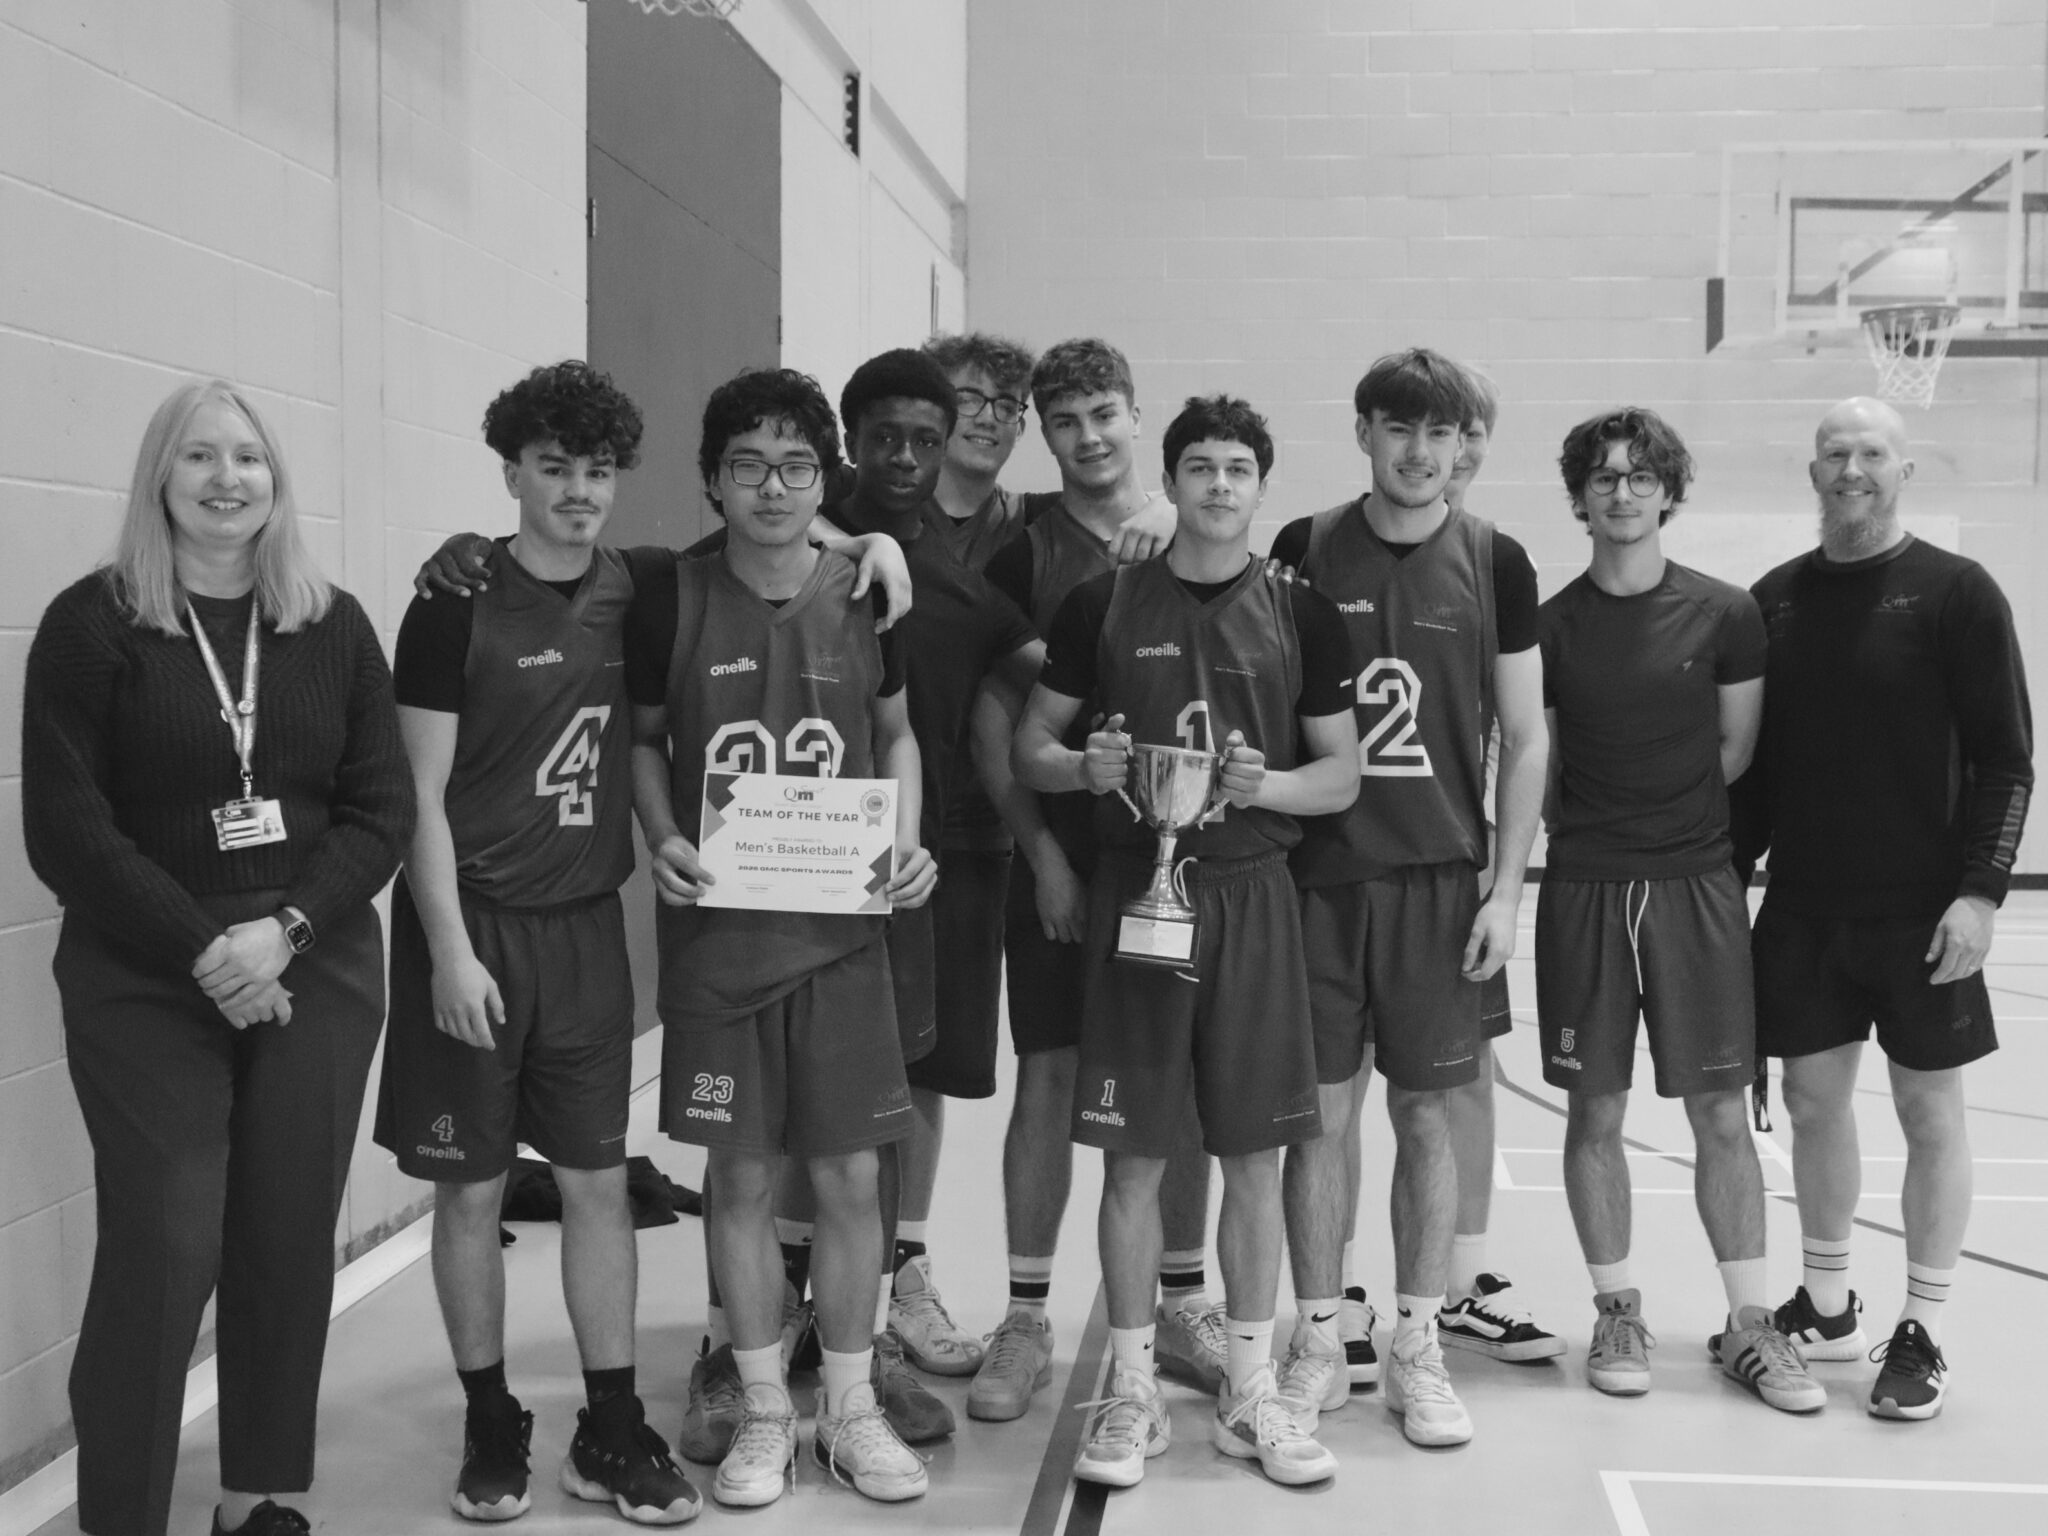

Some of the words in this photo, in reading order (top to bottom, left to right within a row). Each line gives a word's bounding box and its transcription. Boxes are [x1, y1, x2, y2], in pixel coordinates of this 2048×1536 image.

[1357, 657, 1434, 777] 2
[535, 705, 611, 827] 4
[738, 807, 773, 819] TEAM
[776, 810, 794, 820] OF
[797, 811, 822, 821] THE
[825, 813, 859, 823] YEAR
[735, 840, 774, 853] Men's
[777, 843, 847, 857] Basketball
[850, 846, 860, 857] A
[814, 868, 853, 876] AWARDS
[1560, 1027, 1576, 1054] 5
[688, 1072, 736, 1104] 23
[1097, 1078, 1117, 1109] 1
[431, 1114, 456, 1143] 4
